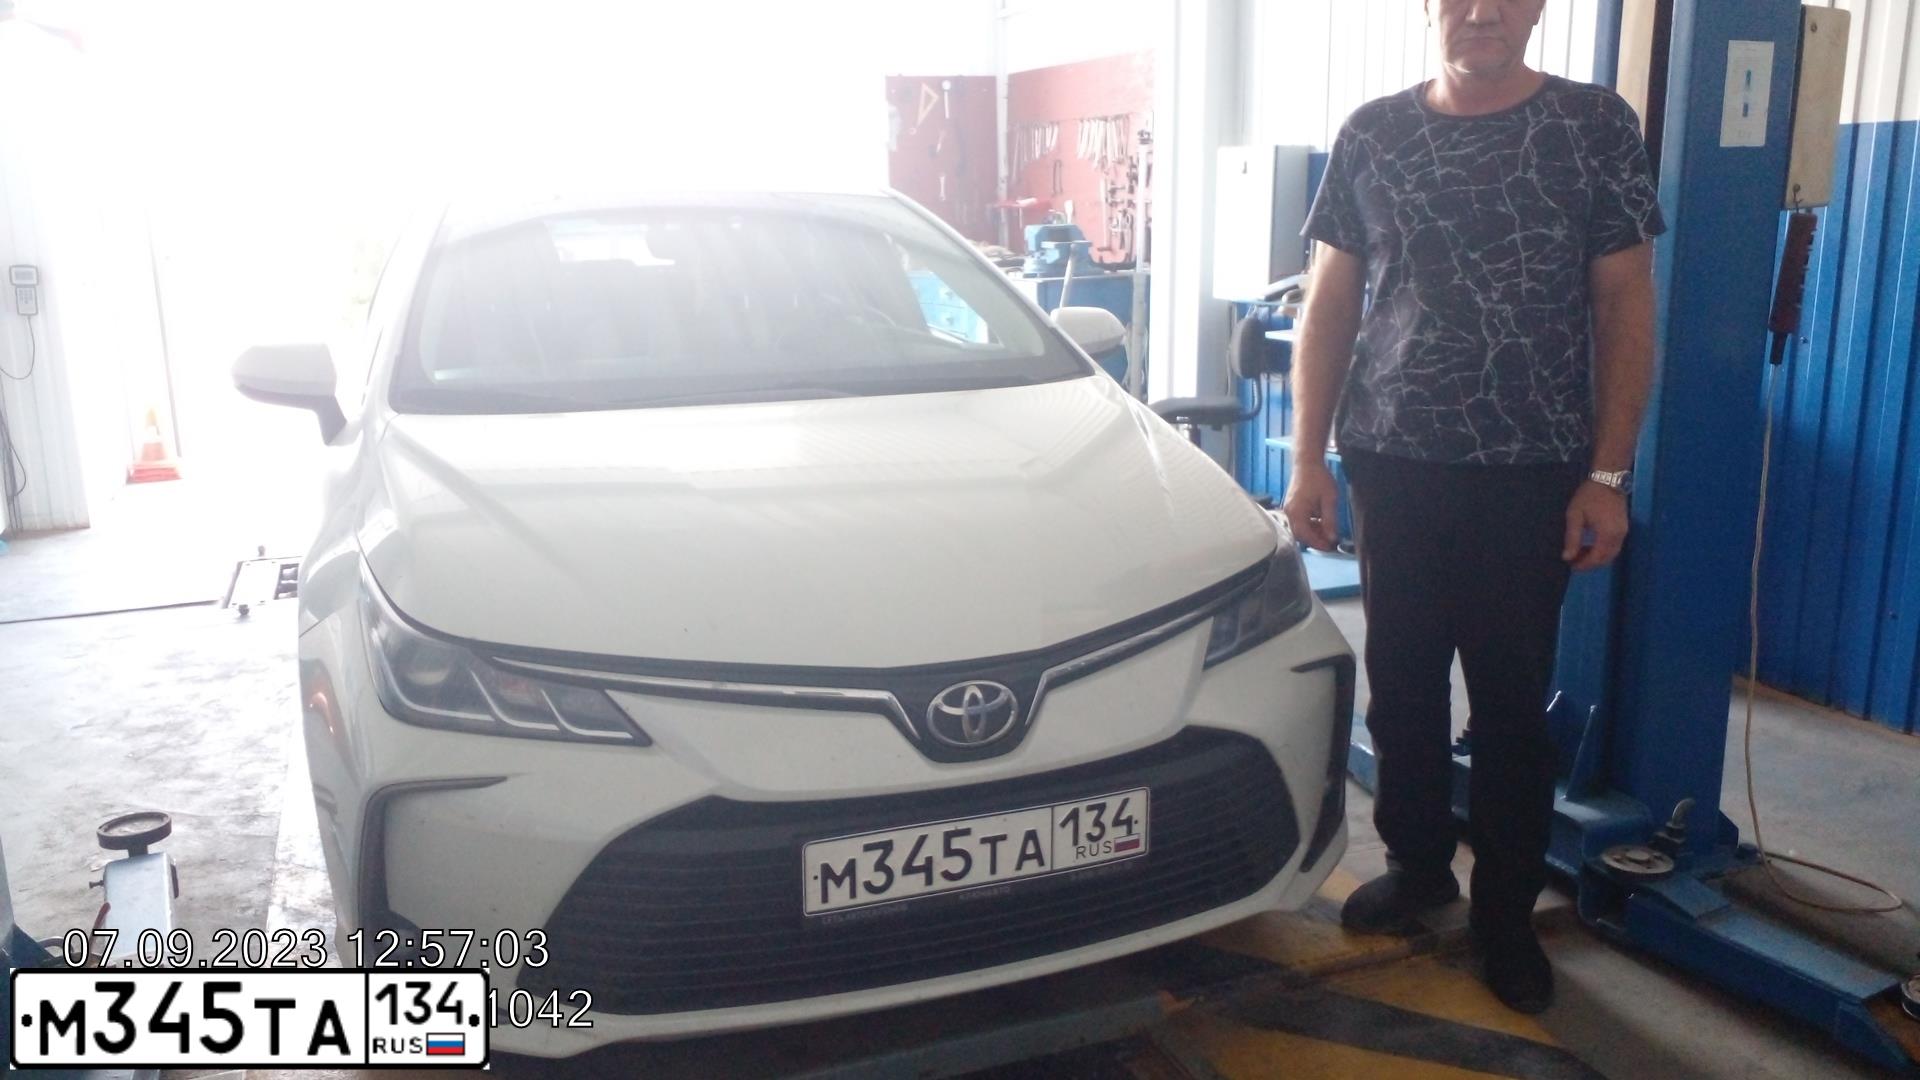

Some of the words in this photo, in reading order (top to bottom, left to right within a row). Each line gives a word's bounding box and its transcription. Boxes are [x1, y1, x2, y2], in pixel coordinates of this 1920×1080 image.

[820, 827, 1046, 904] М345ТА
[1059, 797, 1135, 847] 134
[1075, 840, 1112, 860] RUS
